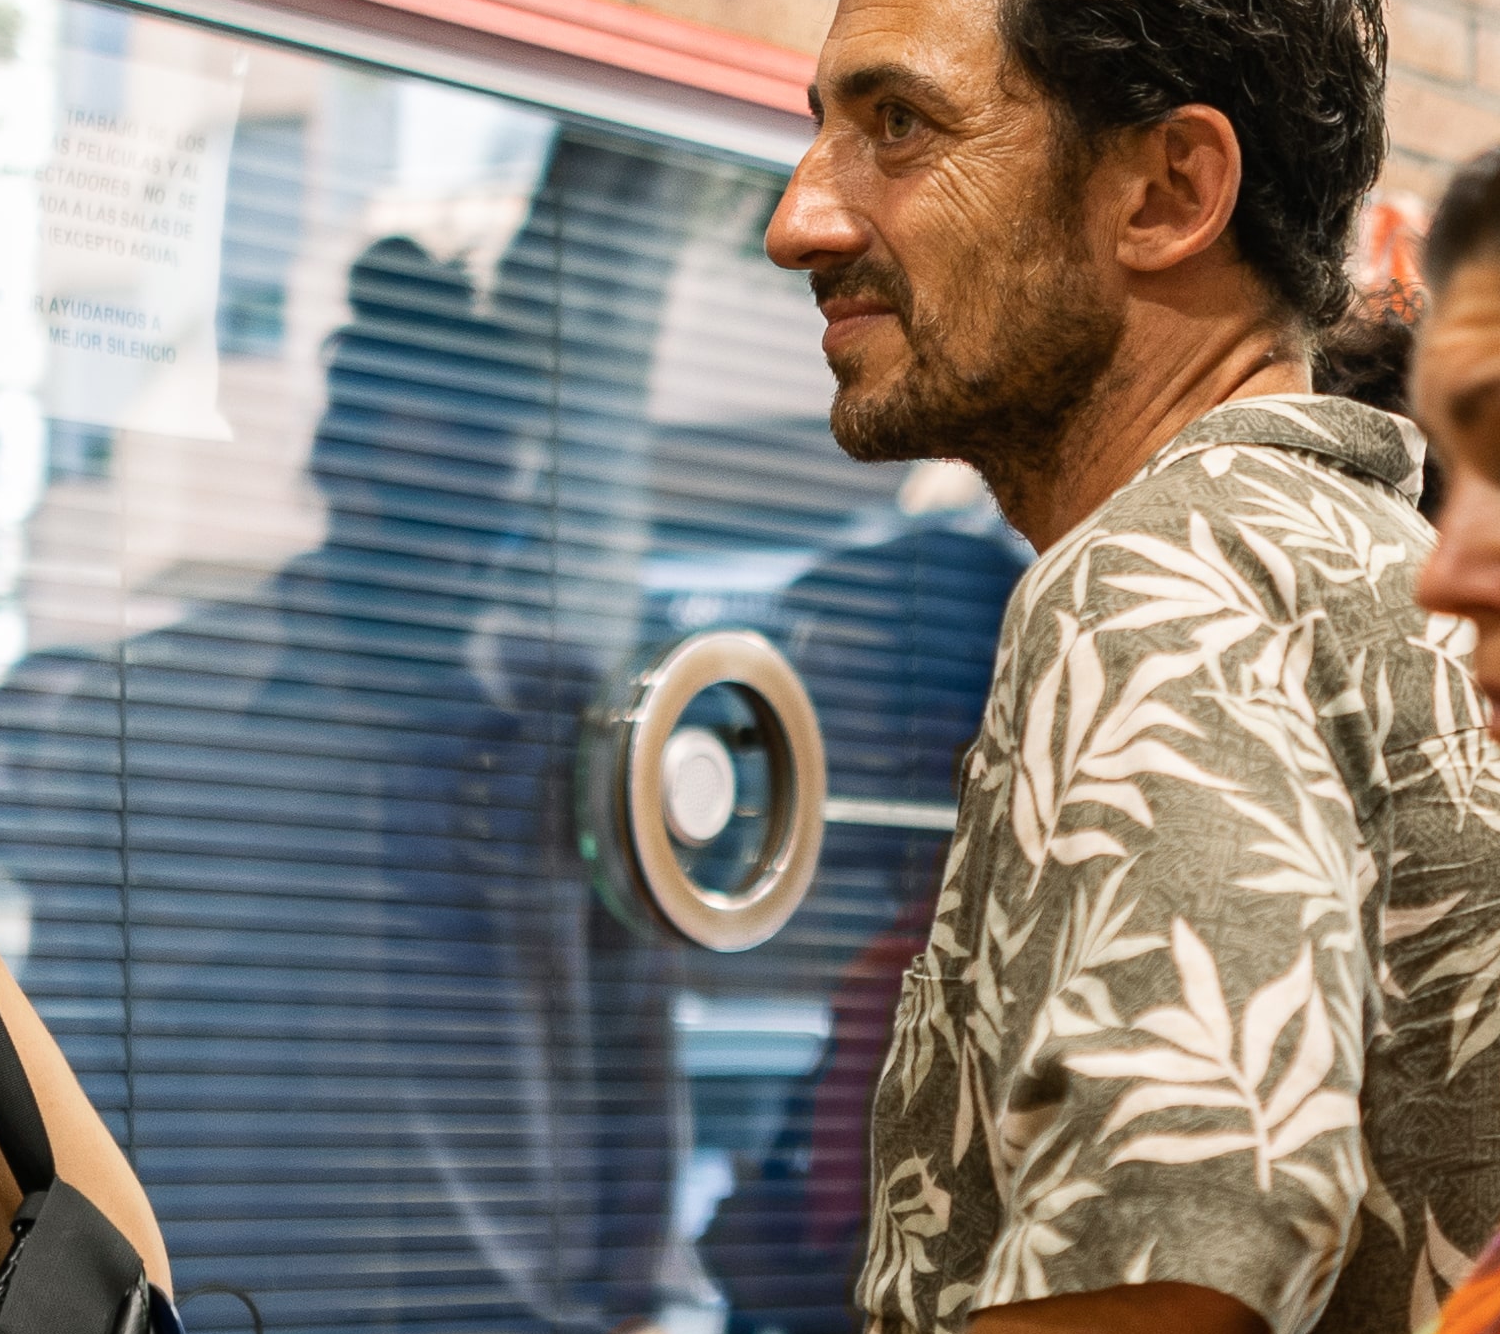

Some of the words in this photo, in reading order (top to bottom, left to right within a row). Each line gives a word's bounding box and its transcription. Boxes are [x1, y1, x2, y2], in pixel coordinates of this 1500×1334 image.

[65, 108, 140, 138] TRABAJO
[177, 132, 206, 154] LOS
[143, 184, 166, 205] NO
[72, 200, 83, 218] A
[87, 202, 115, 226] LAS
[120, 210, 170, 237] SALAS
[173, 220, 193, 241] DE
[49, 296, 146, 330] AYUDARNOS
[49, 326, 101, 351] MEJOR
[107, 336, 176, 364] SILENCIO
